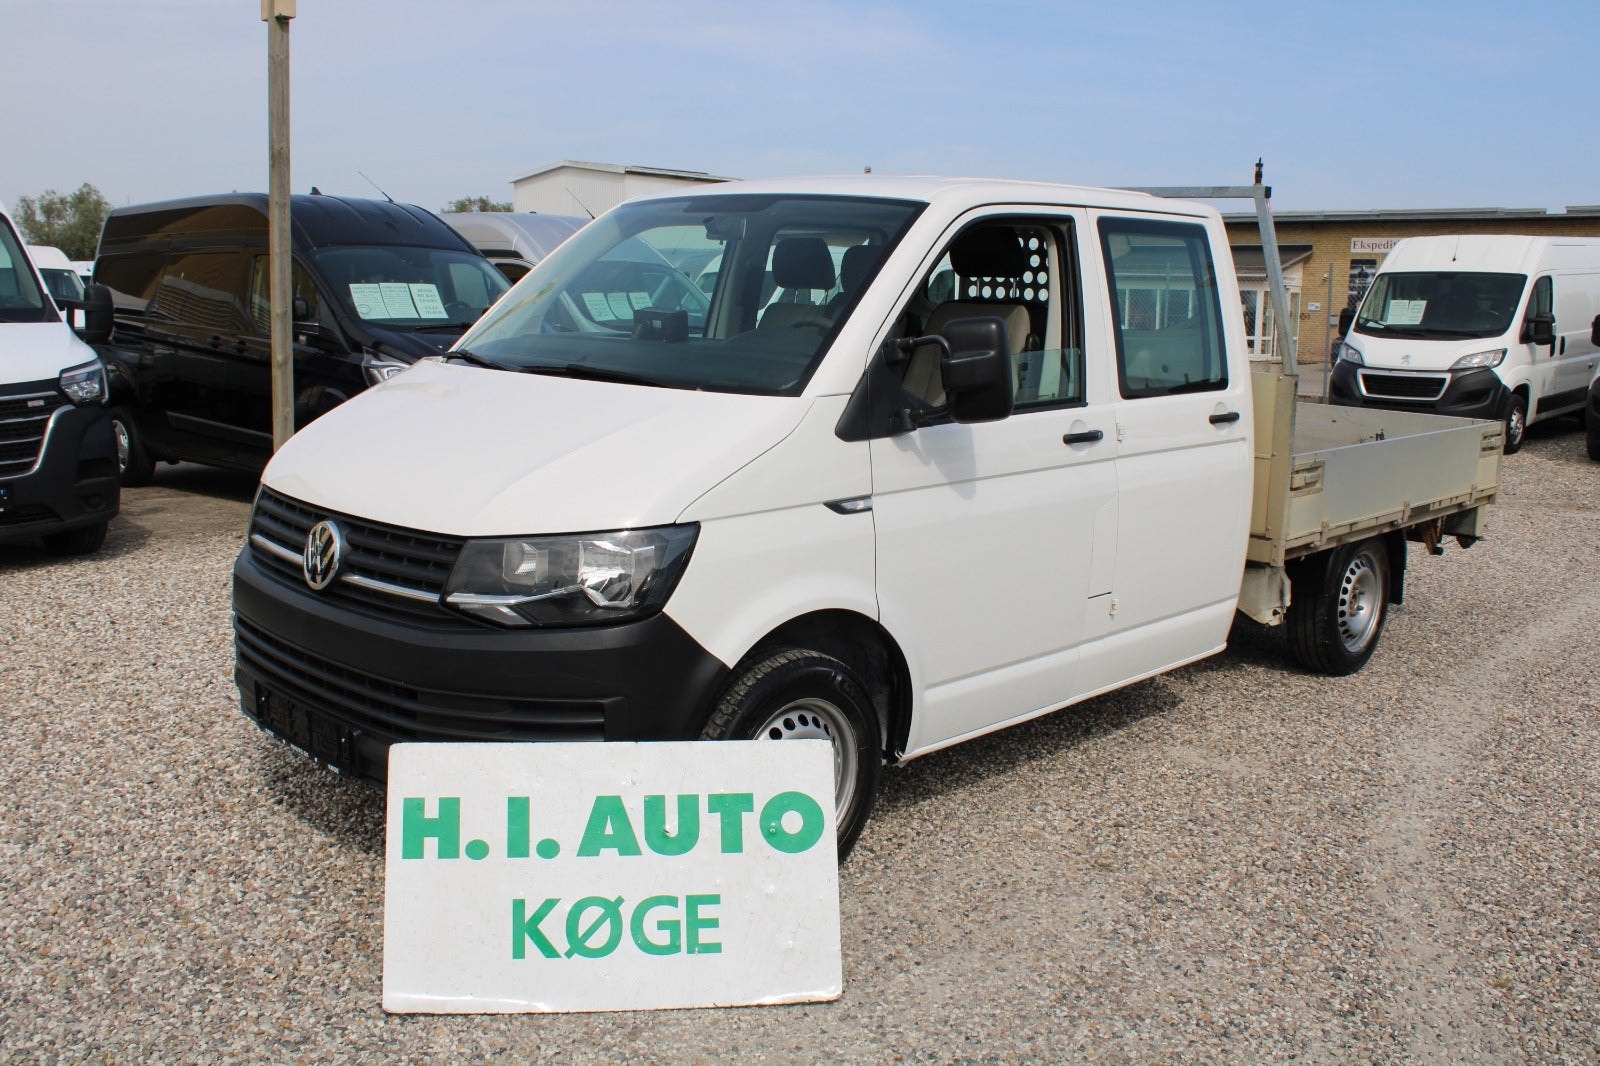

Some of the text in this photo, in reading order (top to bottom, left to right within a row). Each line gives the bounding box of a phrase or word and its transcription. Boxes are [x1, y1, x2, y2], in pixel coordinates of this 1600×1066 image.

[1353, 239, 1399, 251] Ekspedit
[576, 791, 825, 856] AUTO
[512, 894, 722, 960] KØGE
